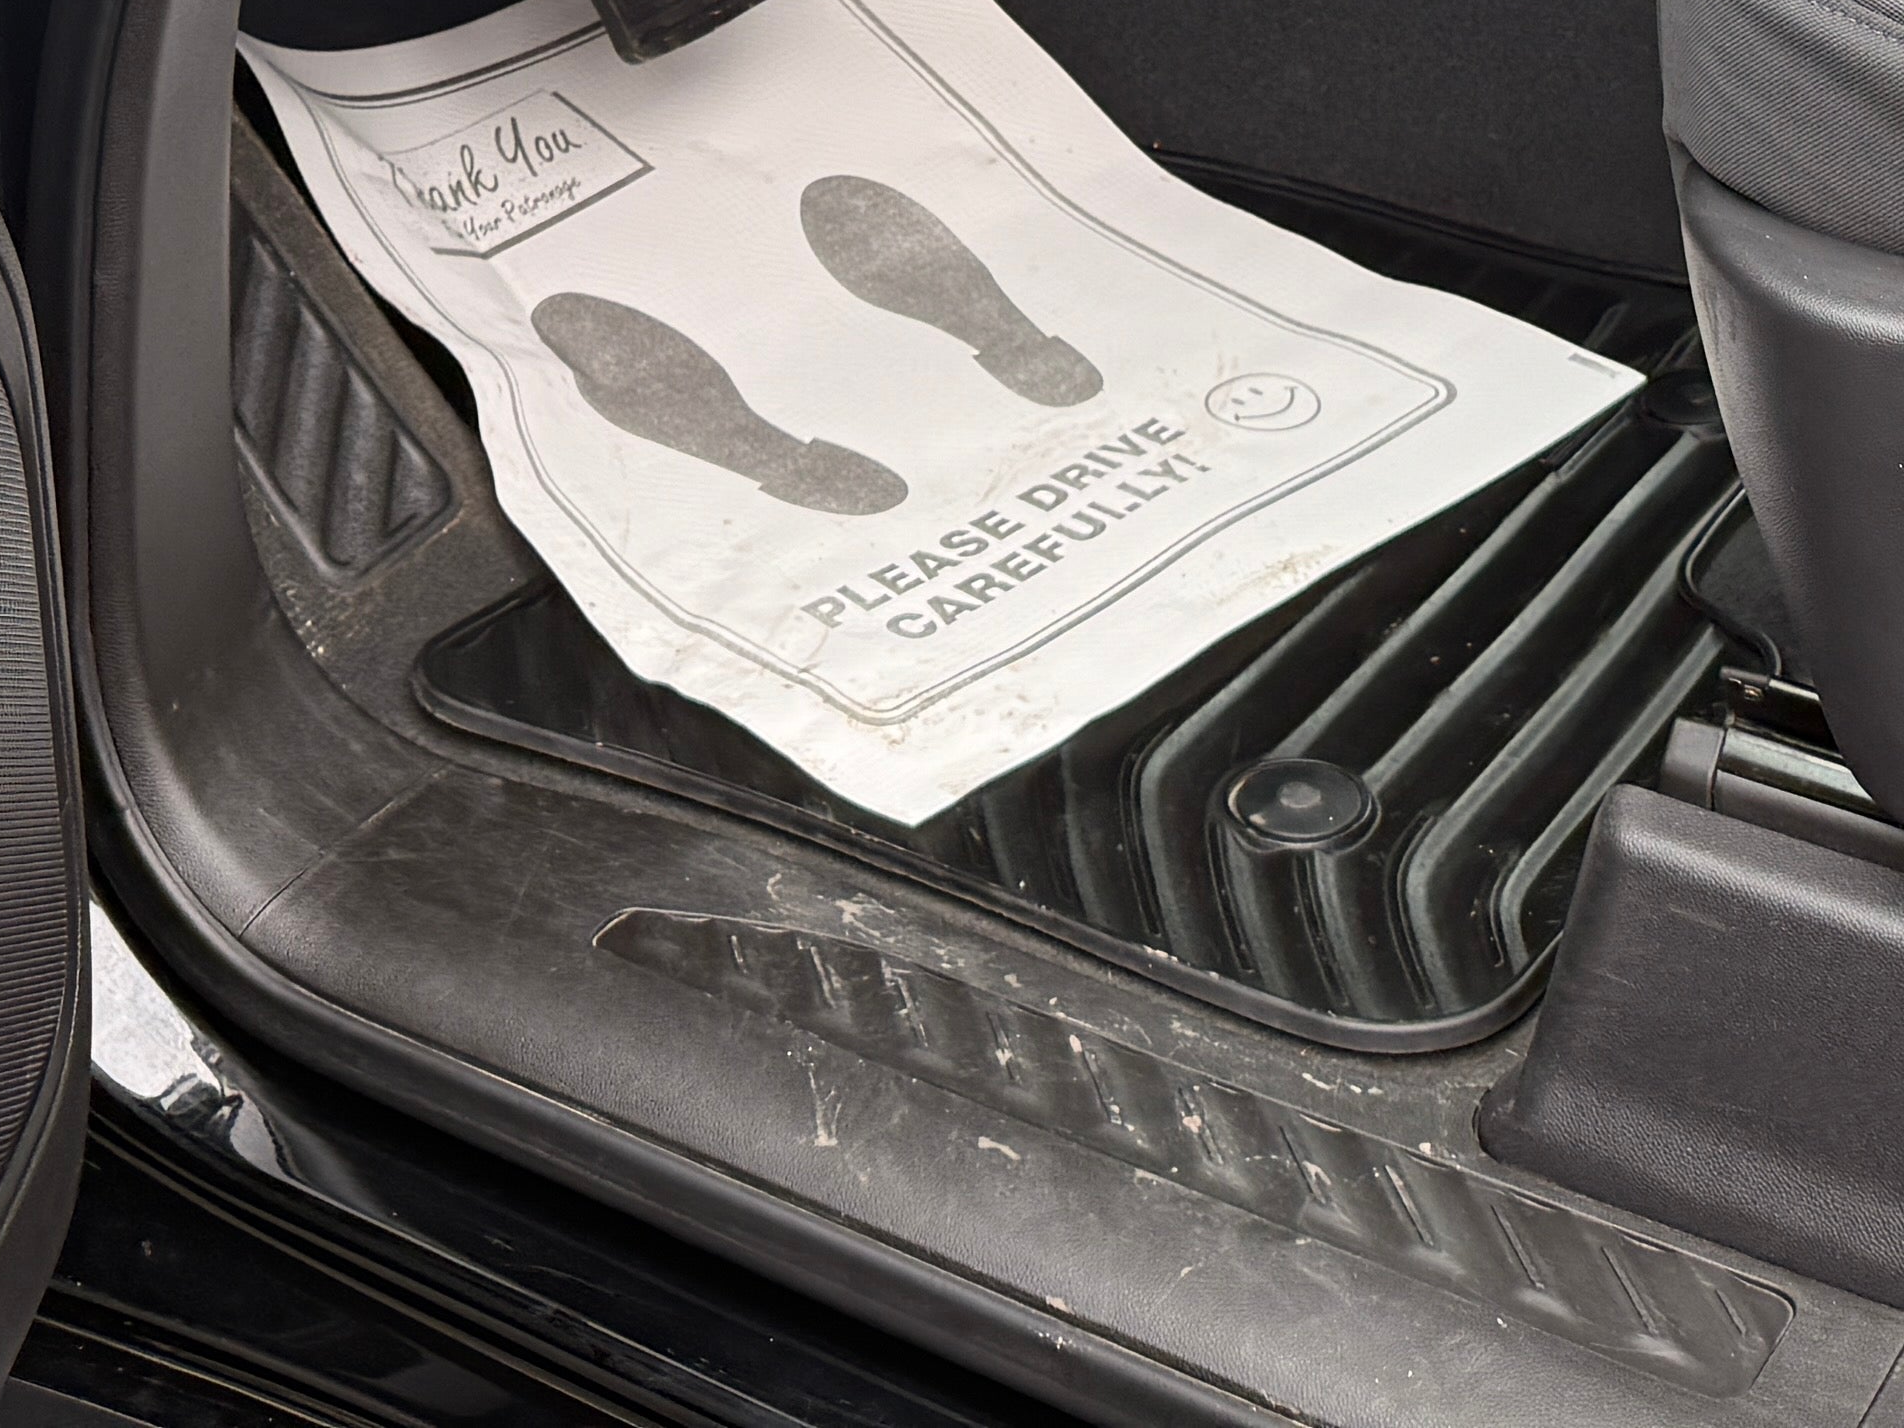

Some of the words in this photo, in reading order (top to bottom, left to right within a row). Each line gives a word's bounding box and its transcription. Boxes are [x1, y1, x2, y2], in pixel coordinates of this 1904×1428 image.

[494, 115, 583, 178] You
[800, 510, 1026, 629] PLEASE
[1016, 417, 1187, 513] DRIVE
[885, 452, 1212, 640] CAREFULLY!
